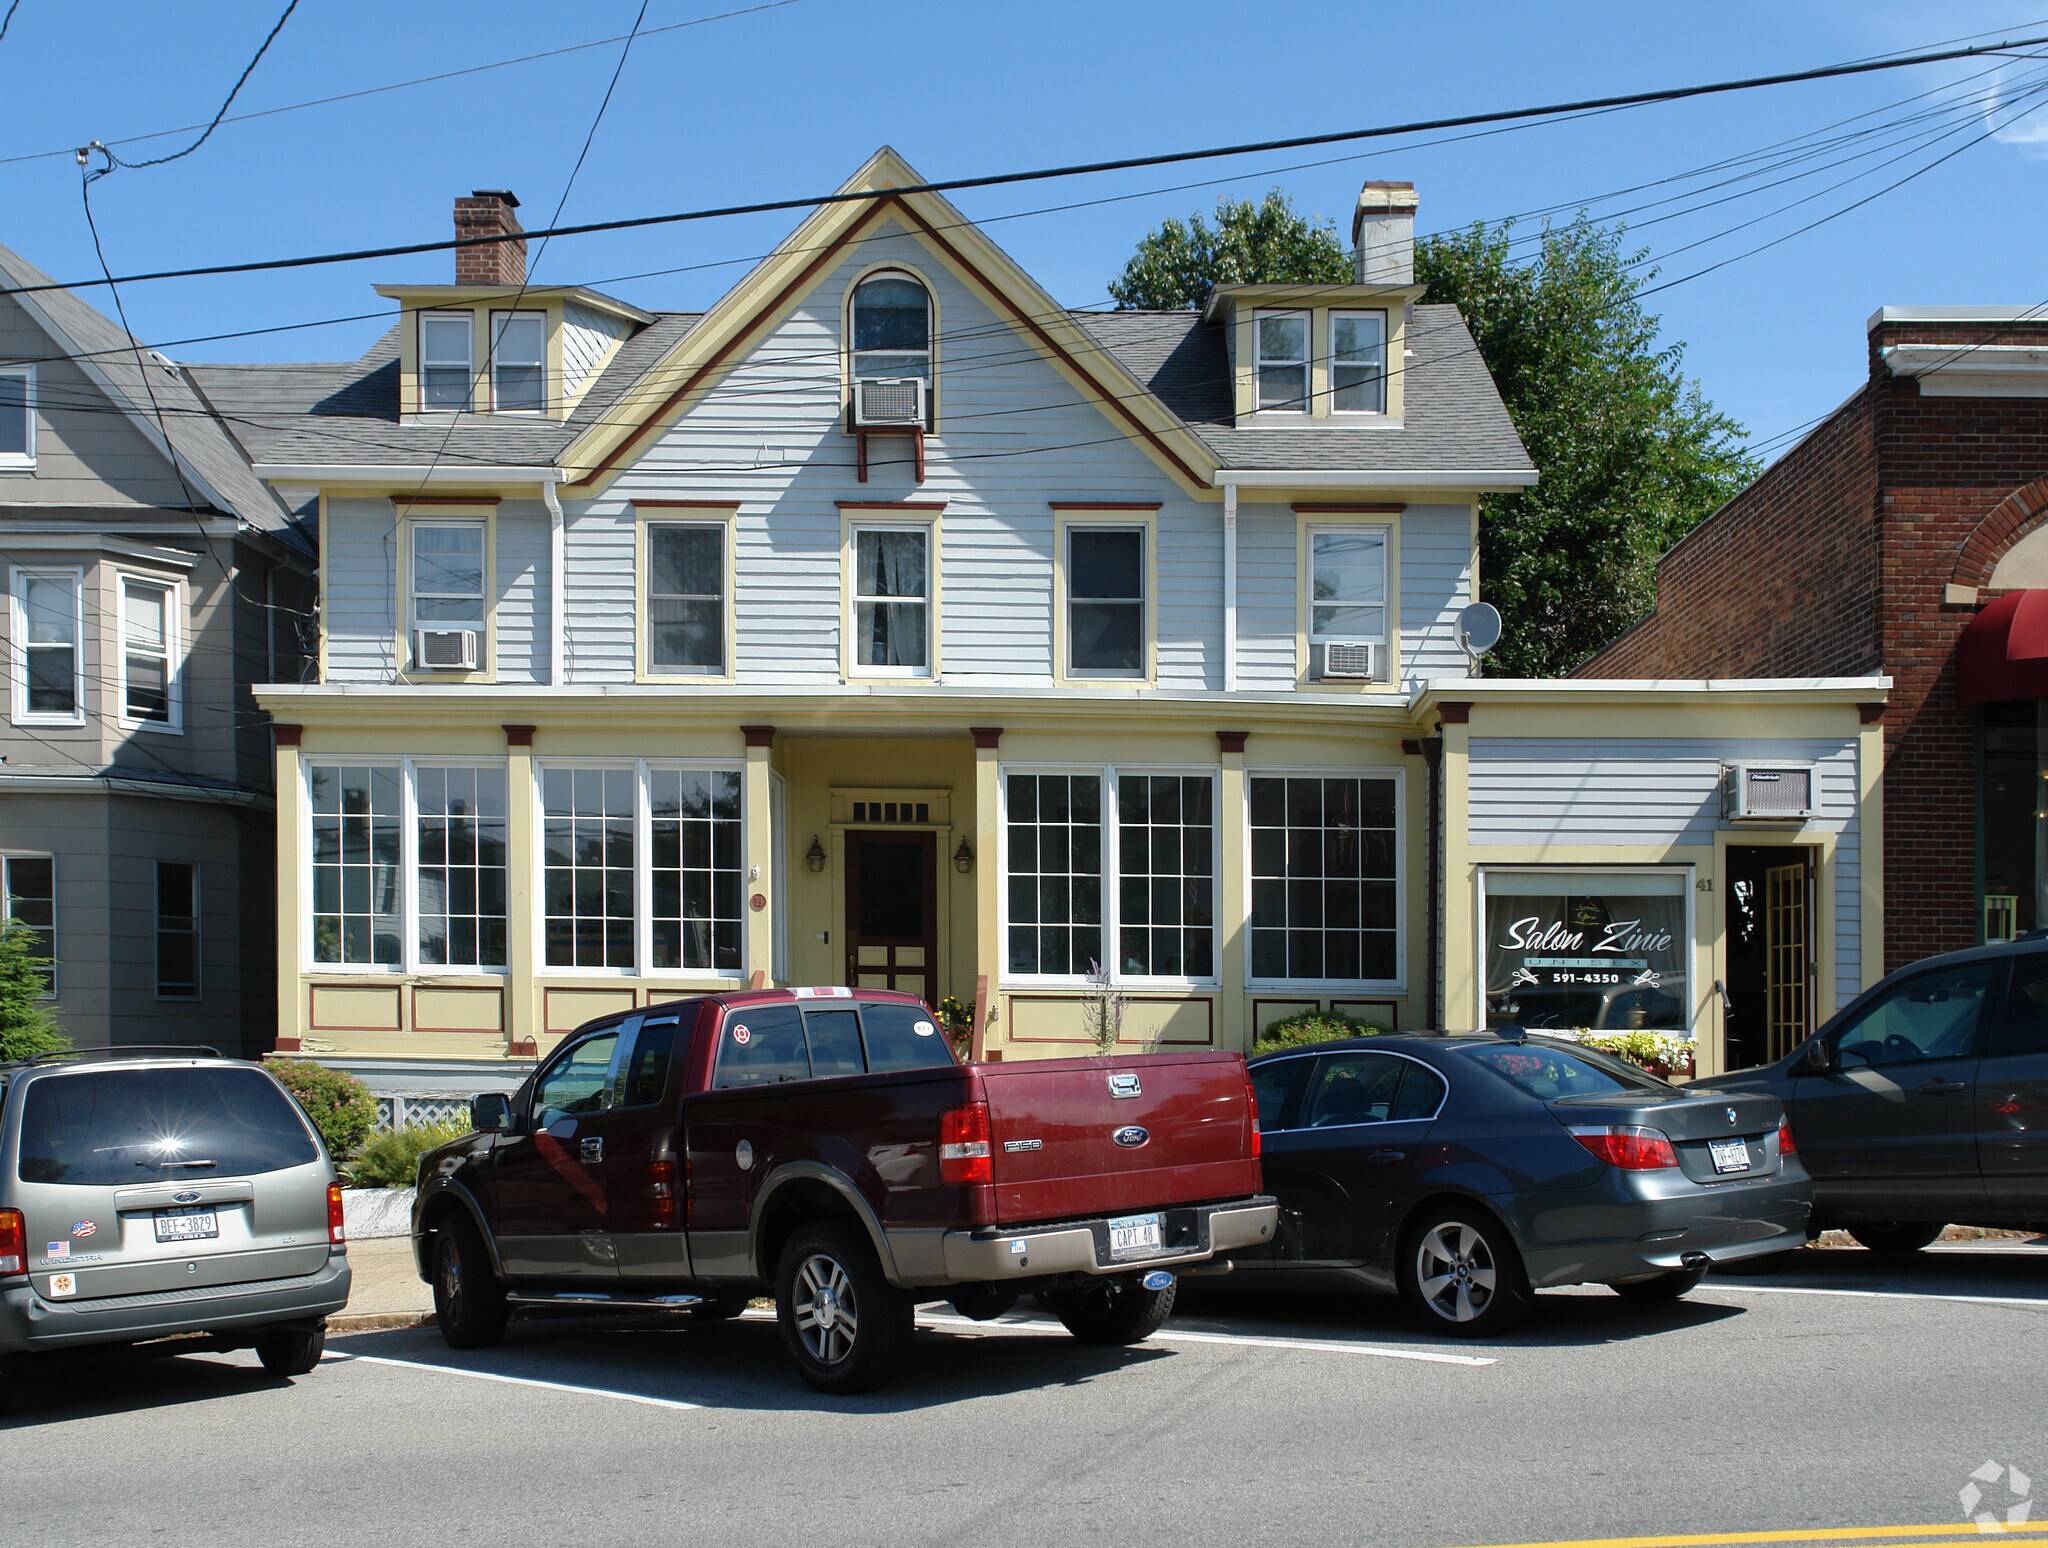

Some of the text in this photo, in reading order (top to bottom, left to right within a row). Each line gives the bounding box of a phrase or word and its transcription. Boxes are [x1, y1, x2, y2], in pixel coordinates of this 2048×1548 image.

[1696, 878, 1714, 892] 41
[1499, 917, 1674, 952] Salon Zinie
[1529, 958, 1642, 967] UNISEX
[1553, 973, 1620, 984] 591-4350
[1123, 1130, 1143, 1143] Ford
[1117, 1226, 1153, 1248] CAPT 48
[40, 1254, 104, 1266] WINDSTAR
